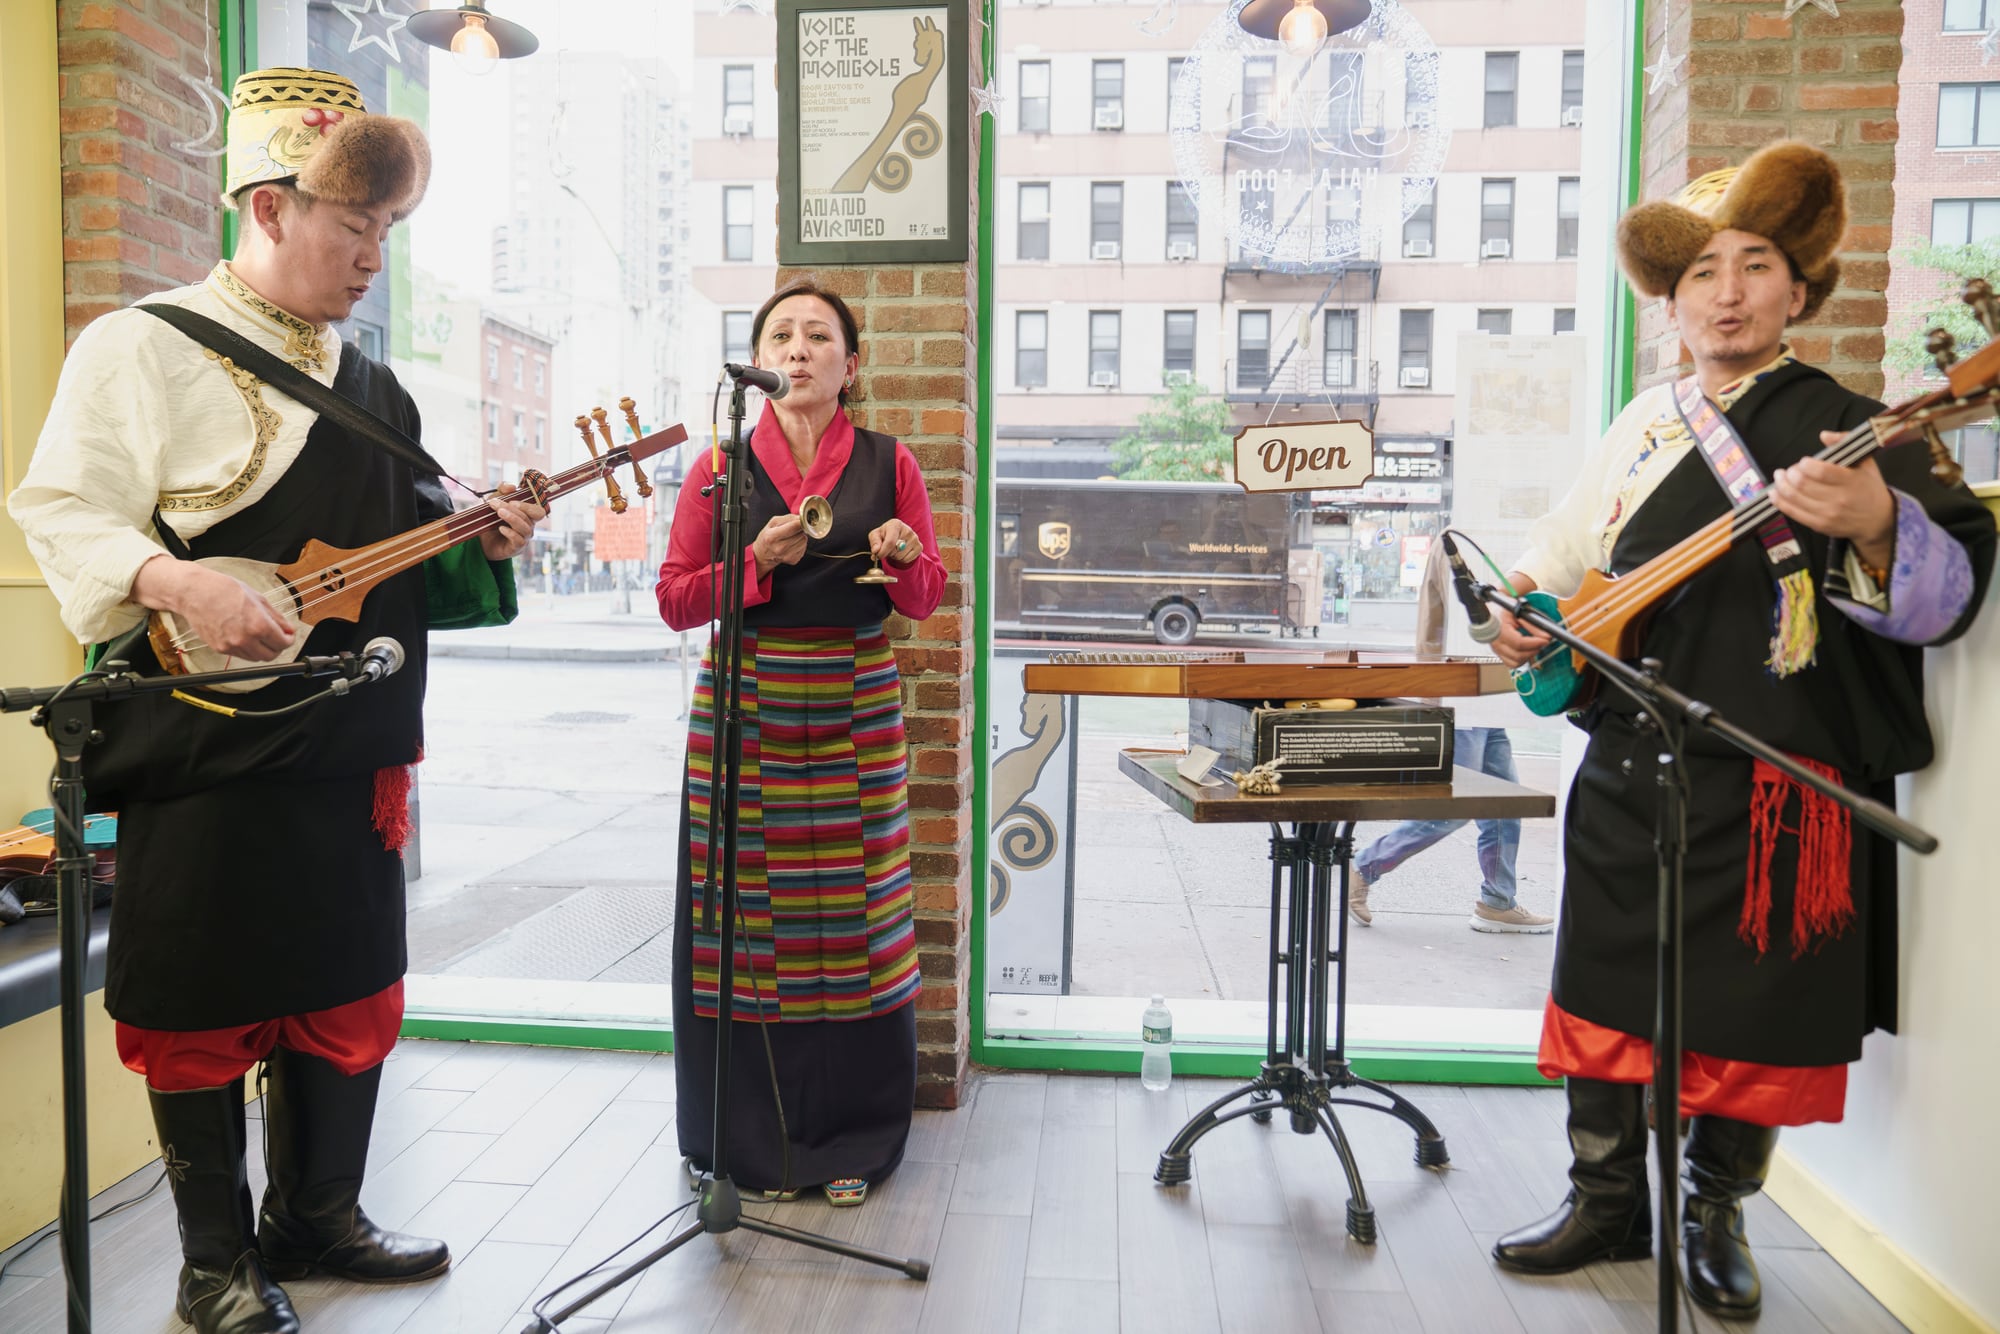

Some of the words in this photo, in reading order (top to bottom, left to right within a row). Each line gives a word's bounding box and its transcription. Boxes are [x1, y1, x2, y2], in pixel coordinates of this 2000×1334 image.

[802, 17, 855, 36] VOICE
[802, 39, 830, 57] OF
[835, 38, 868, 56] THE
[802, 58, 900, 78] MONGOLS
[802, 198, 866, 217] ANAND
[803, 218, 884, 238] AVIRMED
[1258, 438, 1351, 483] Open
[1040, 532, 1068, 554] ups
[1189, 542, 1232, 553] Worldwide
[1233, 543, 1268, 554] Services
